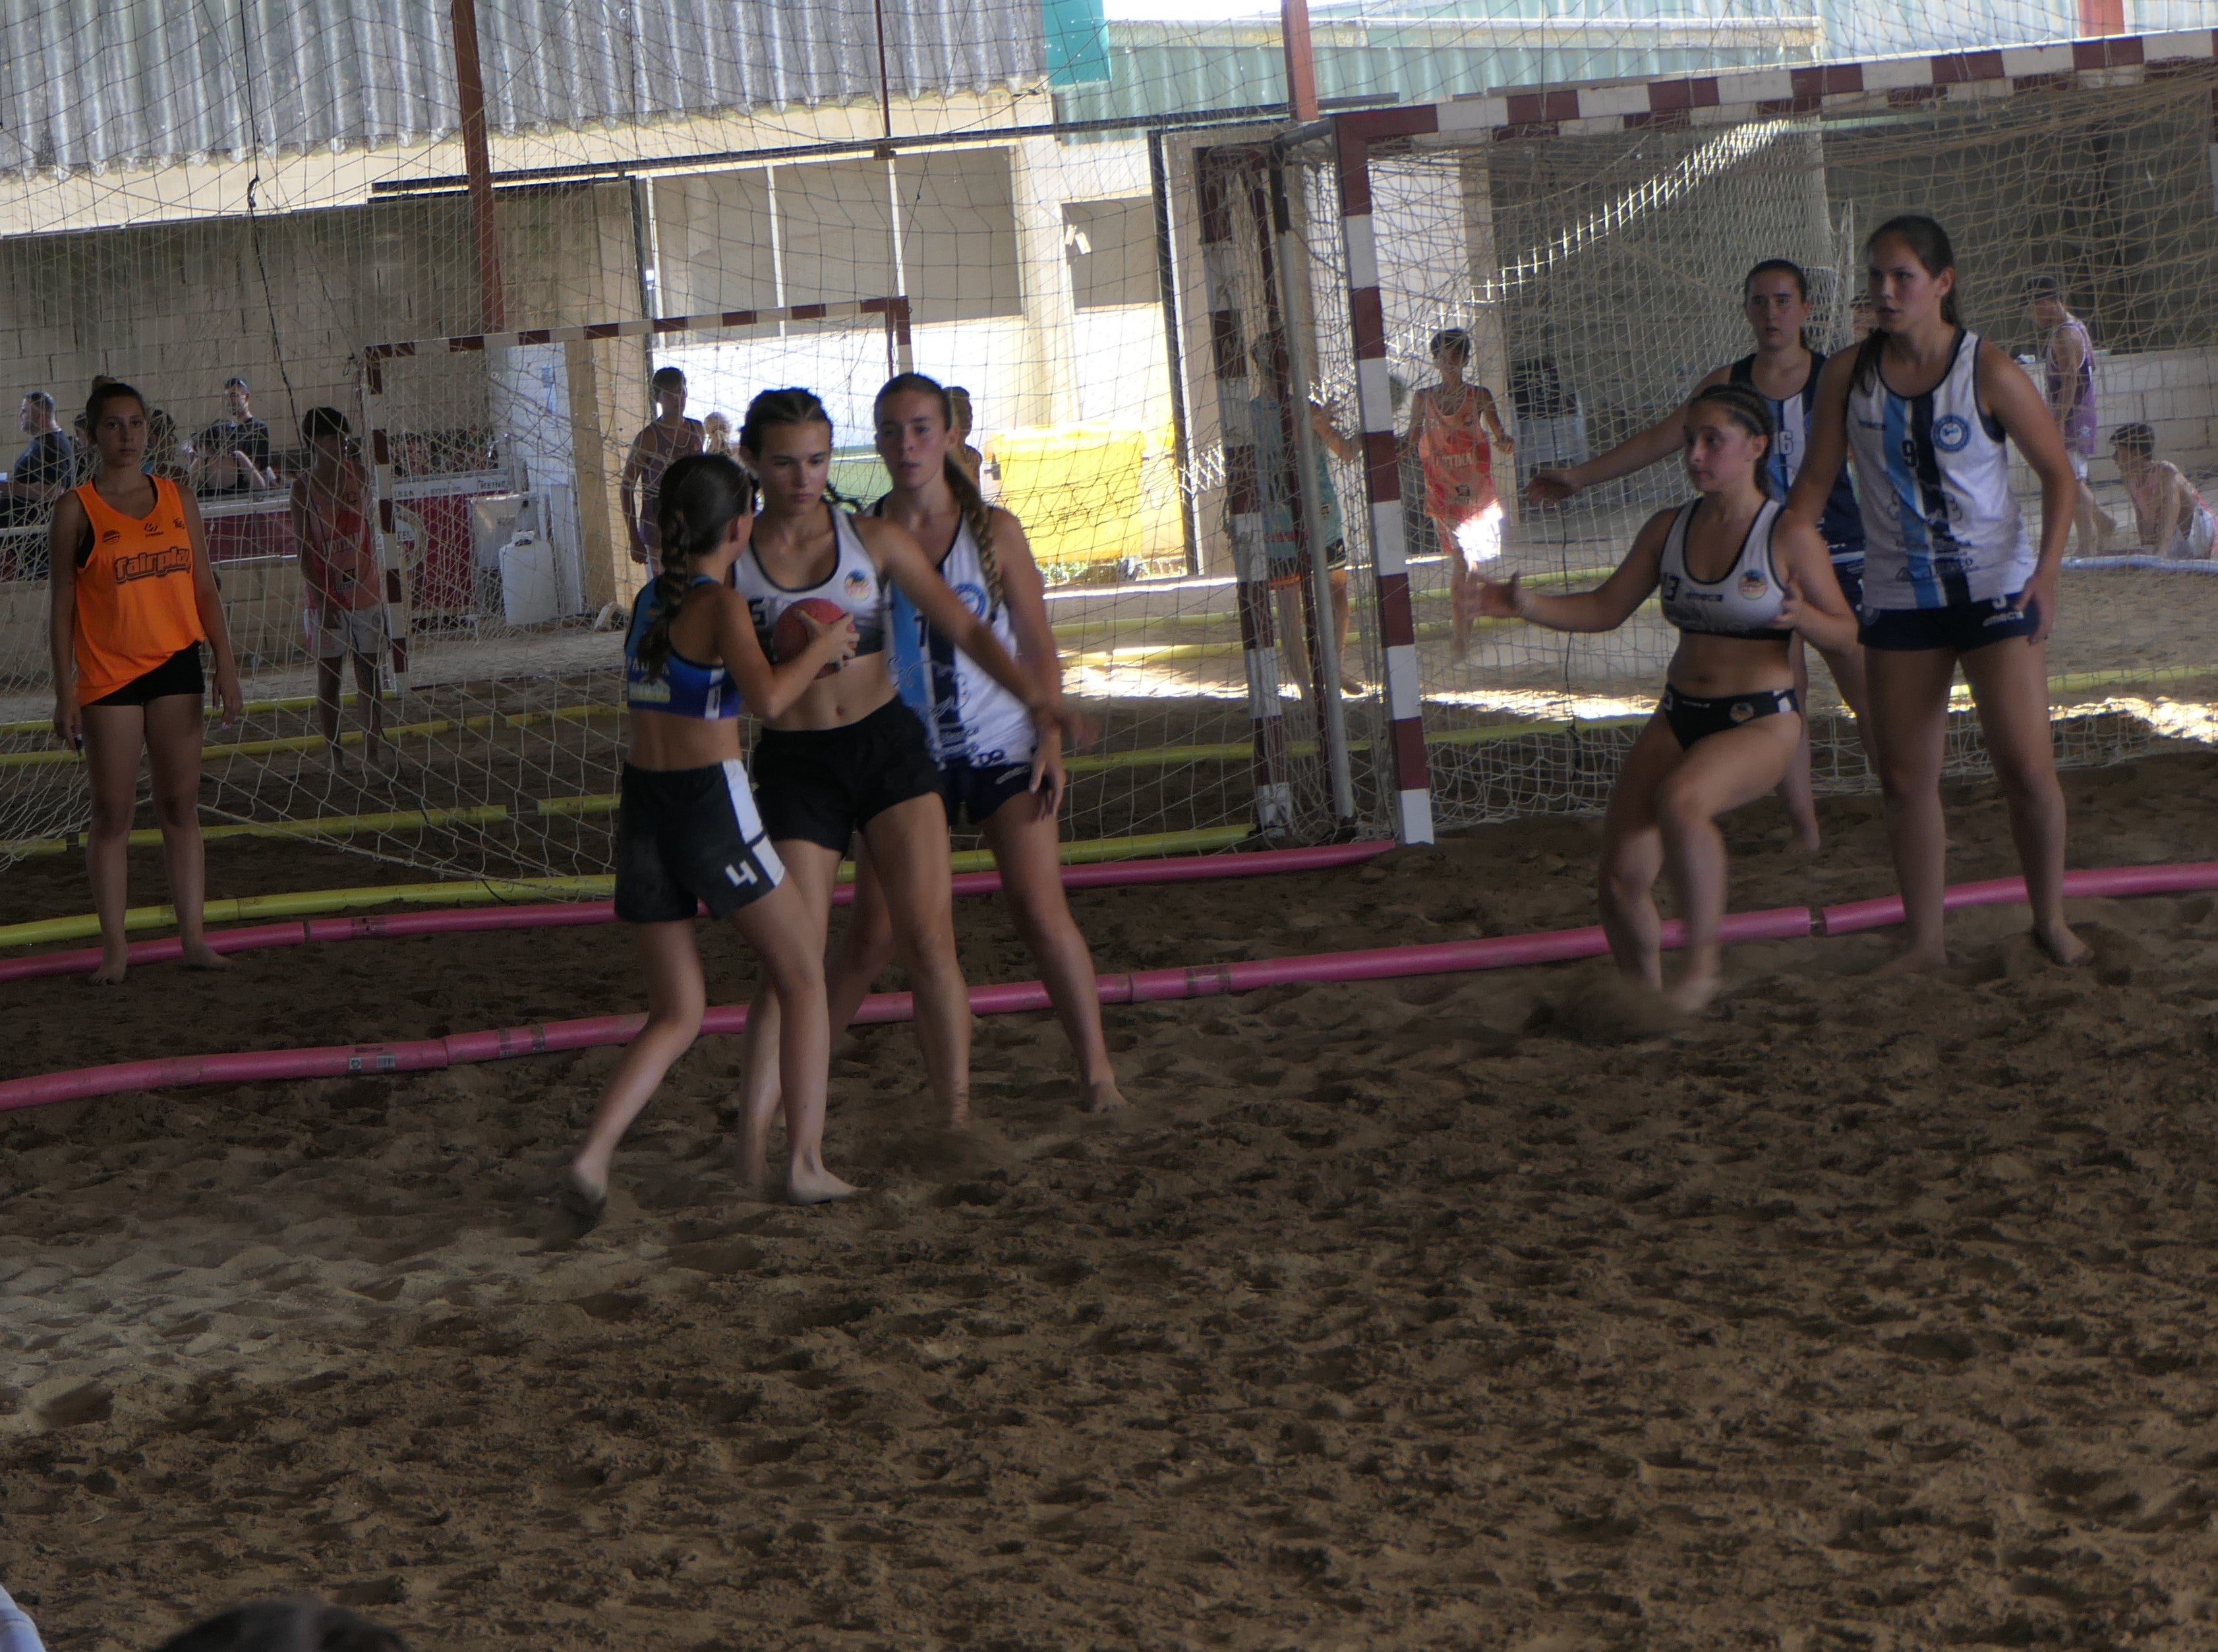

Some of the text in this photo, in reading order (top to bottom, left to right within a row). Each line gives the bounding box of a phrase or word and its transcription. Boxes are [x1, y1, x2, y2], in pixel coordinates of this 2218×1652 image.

[1902, 440, 1918, 467] 9
[914, 614, 929, 647] 7
[725, 860, 759, 887] 4
